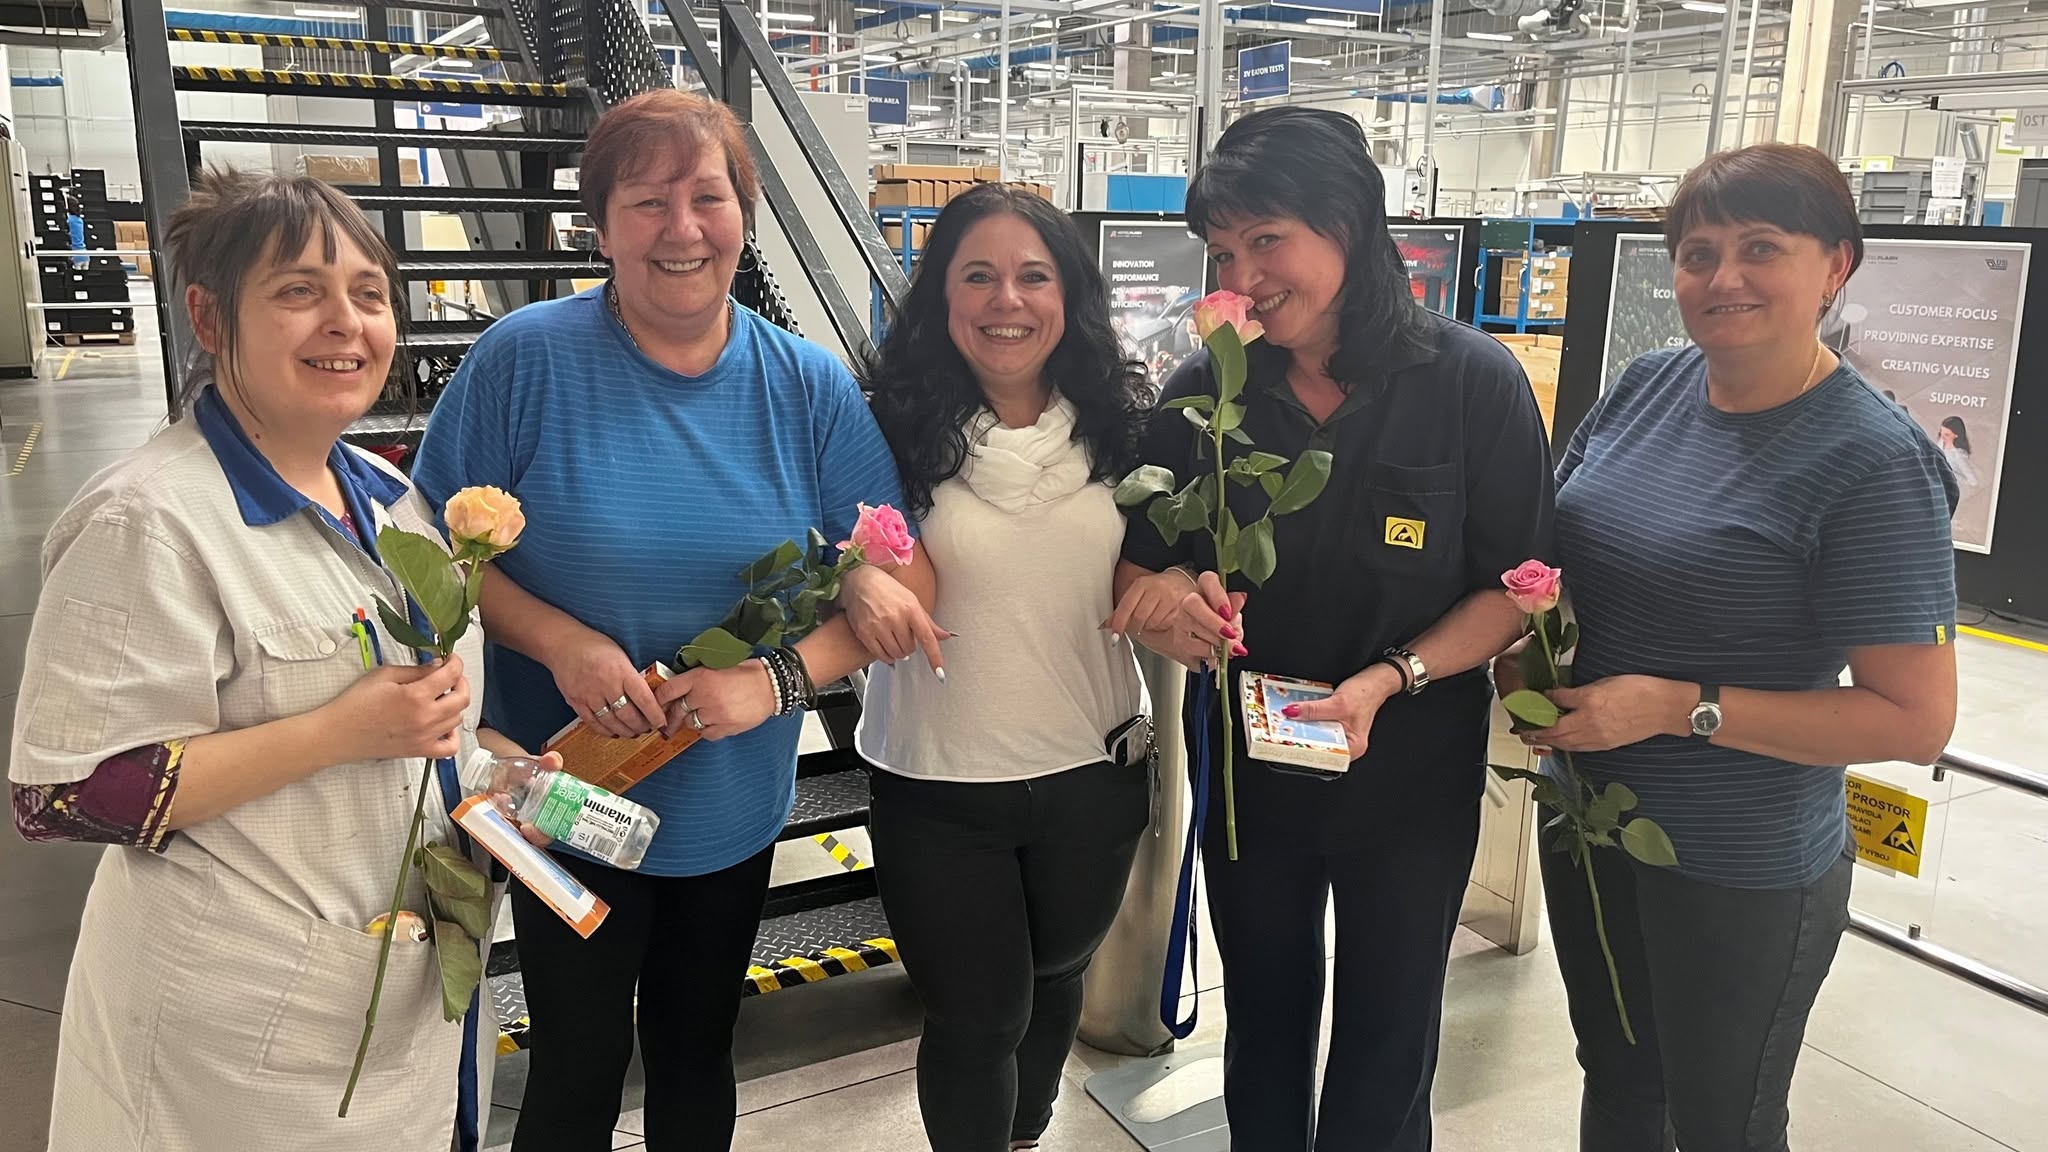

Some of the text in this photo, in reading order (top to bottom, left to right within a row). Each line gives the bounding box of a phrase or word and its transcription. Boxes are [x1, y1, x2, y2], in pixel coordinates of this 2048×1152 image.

[1269, 64, 1284, 73] TESTS
[1653, 289, 1671, 299] ECO
[1889, 303, 1999, 321] CUSTOMER FOCUS
[1667, 336, 1685, 346] CSR
[1863, 330, 1995, 350] PROVIDING EXPERTISE
[1881, 359, 1991, 379] CREATING VALUES
[1929, 391, 1987, 408] SUPPORT
[1853, 792, 1911, 819] PROSTOR
